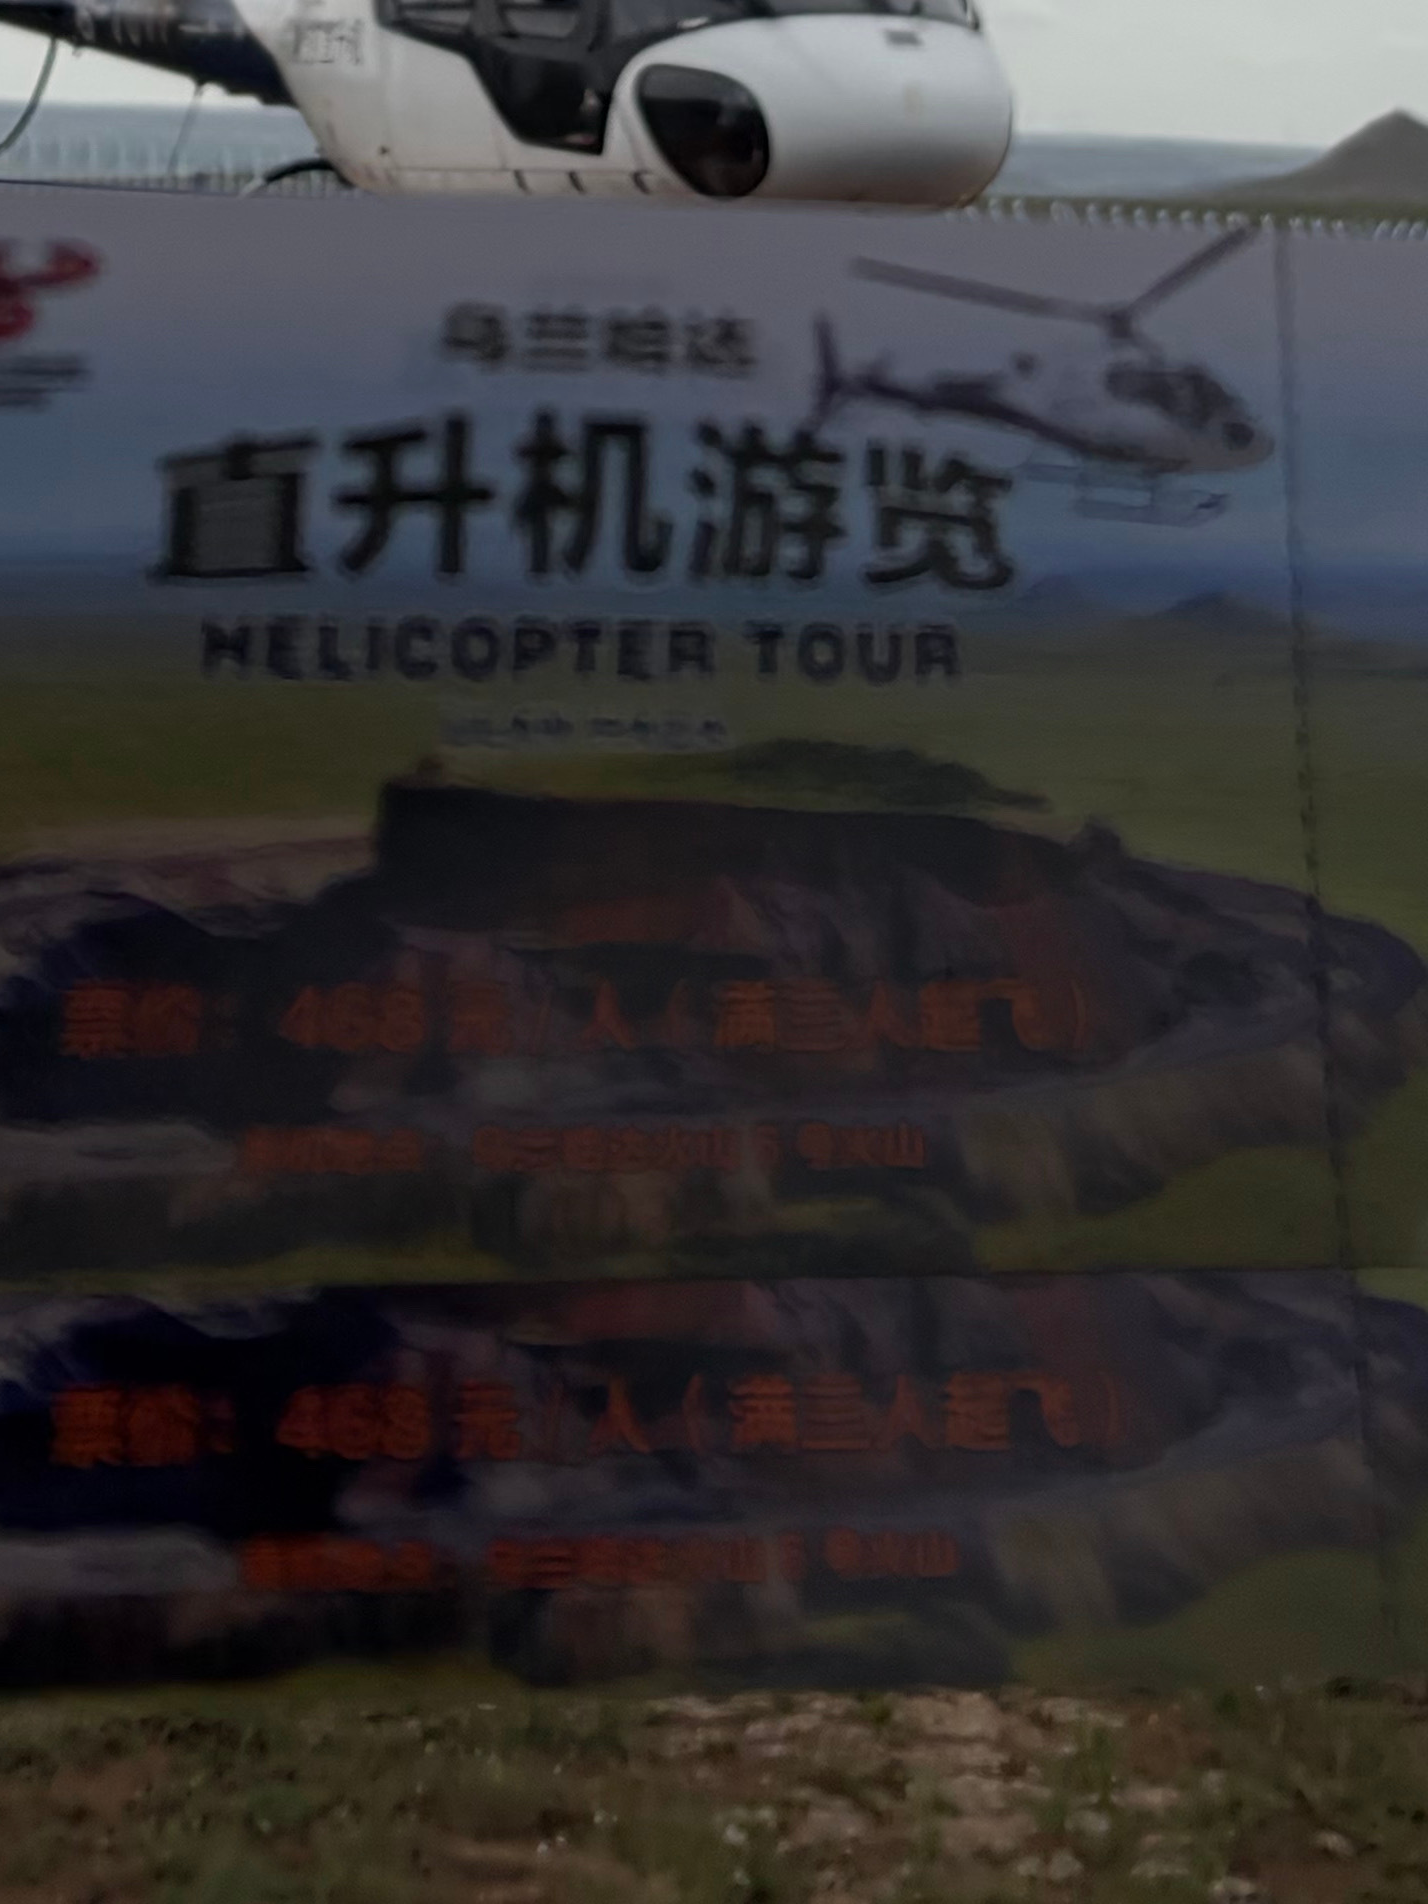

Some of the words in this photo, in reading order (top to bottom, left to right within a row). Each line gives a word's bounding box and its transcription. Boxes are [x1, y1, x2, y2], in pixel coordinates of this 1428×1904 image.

[151, 412, 1017, 590] 直升机游览
[201, 616, 719, 682] HELICOPTER
[752, 618, 963, 682] TOUR
